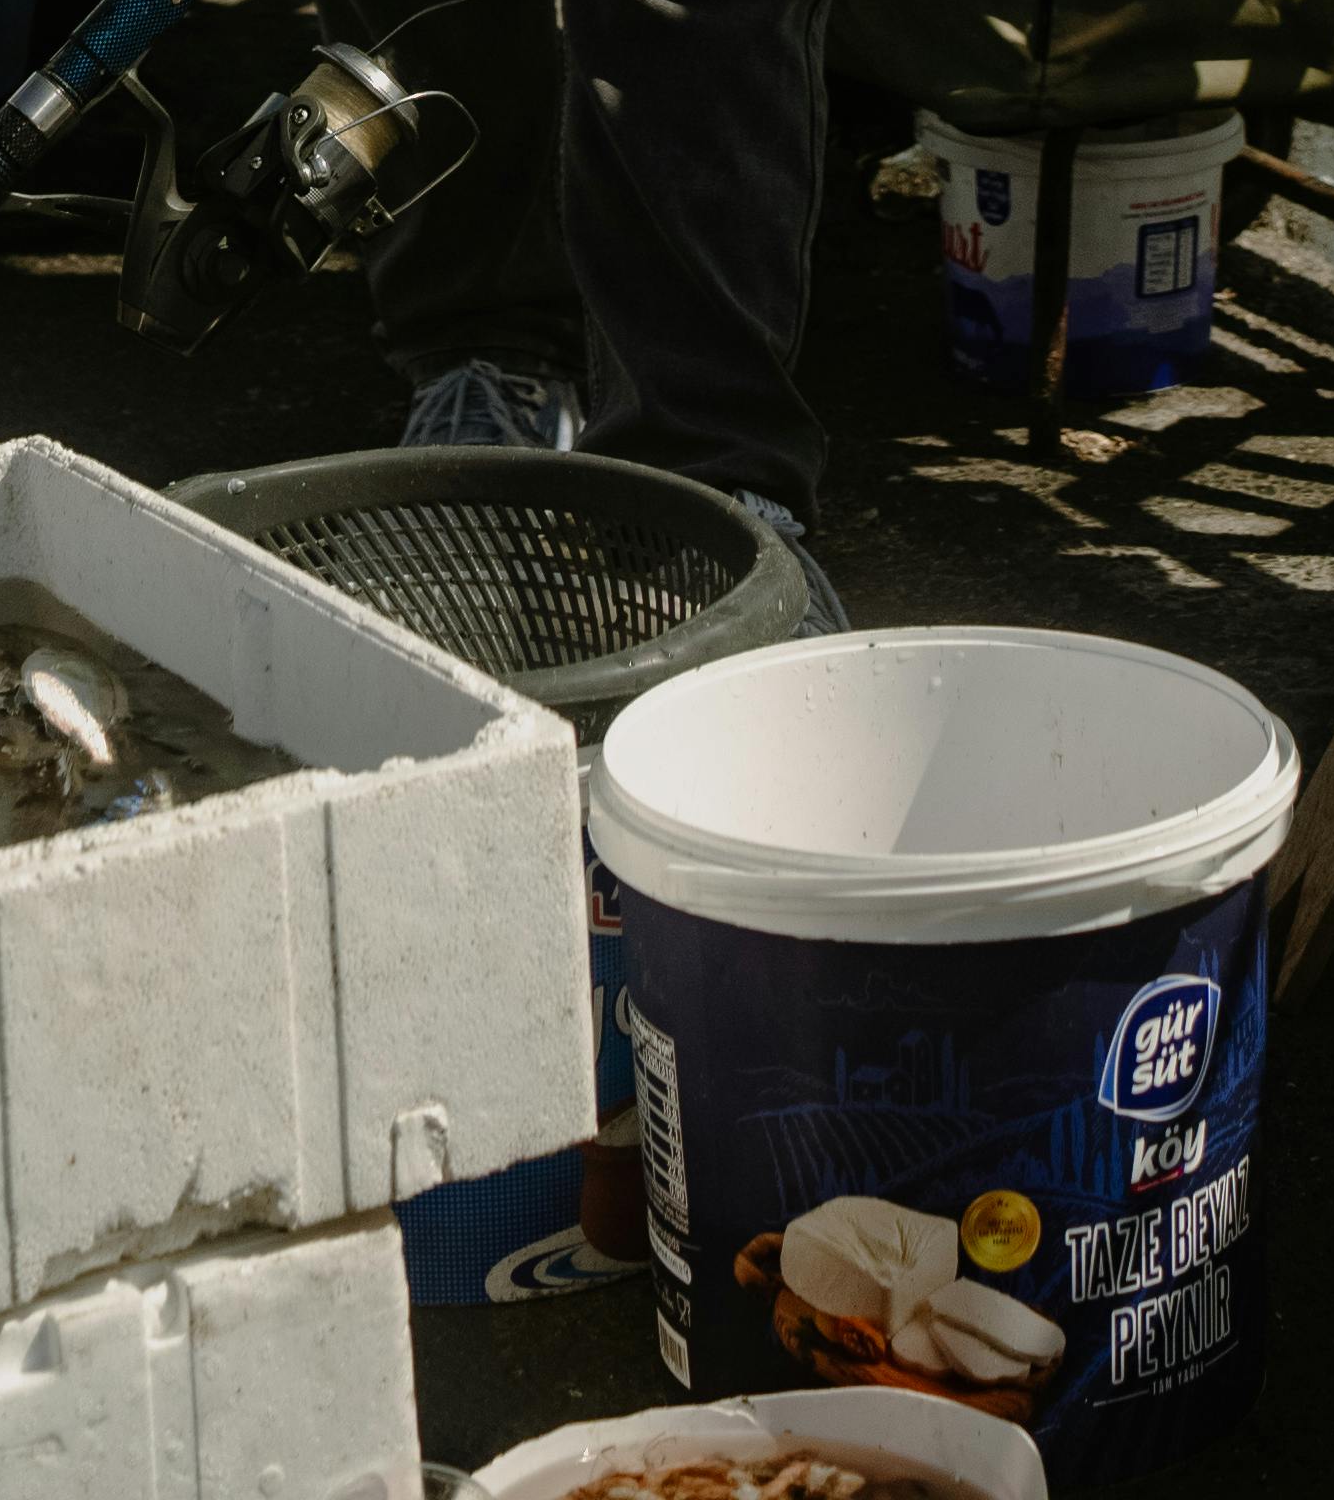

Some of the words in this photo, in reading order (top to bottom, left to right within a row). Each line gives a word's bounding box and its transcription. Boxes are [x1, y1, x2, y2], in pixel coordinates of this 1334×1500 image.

[1134, 998, 1203, 1064] gür
[1131, 1045, 1196, 1096] süt
[1131, 1117, 1208, 1185] köy
[1065, 1206, 1164, 1306] TAZE
[1170, 1153, 1252, 1276] BEYAZ
[1110, 1263, 1232, 1387] PEYNİR
